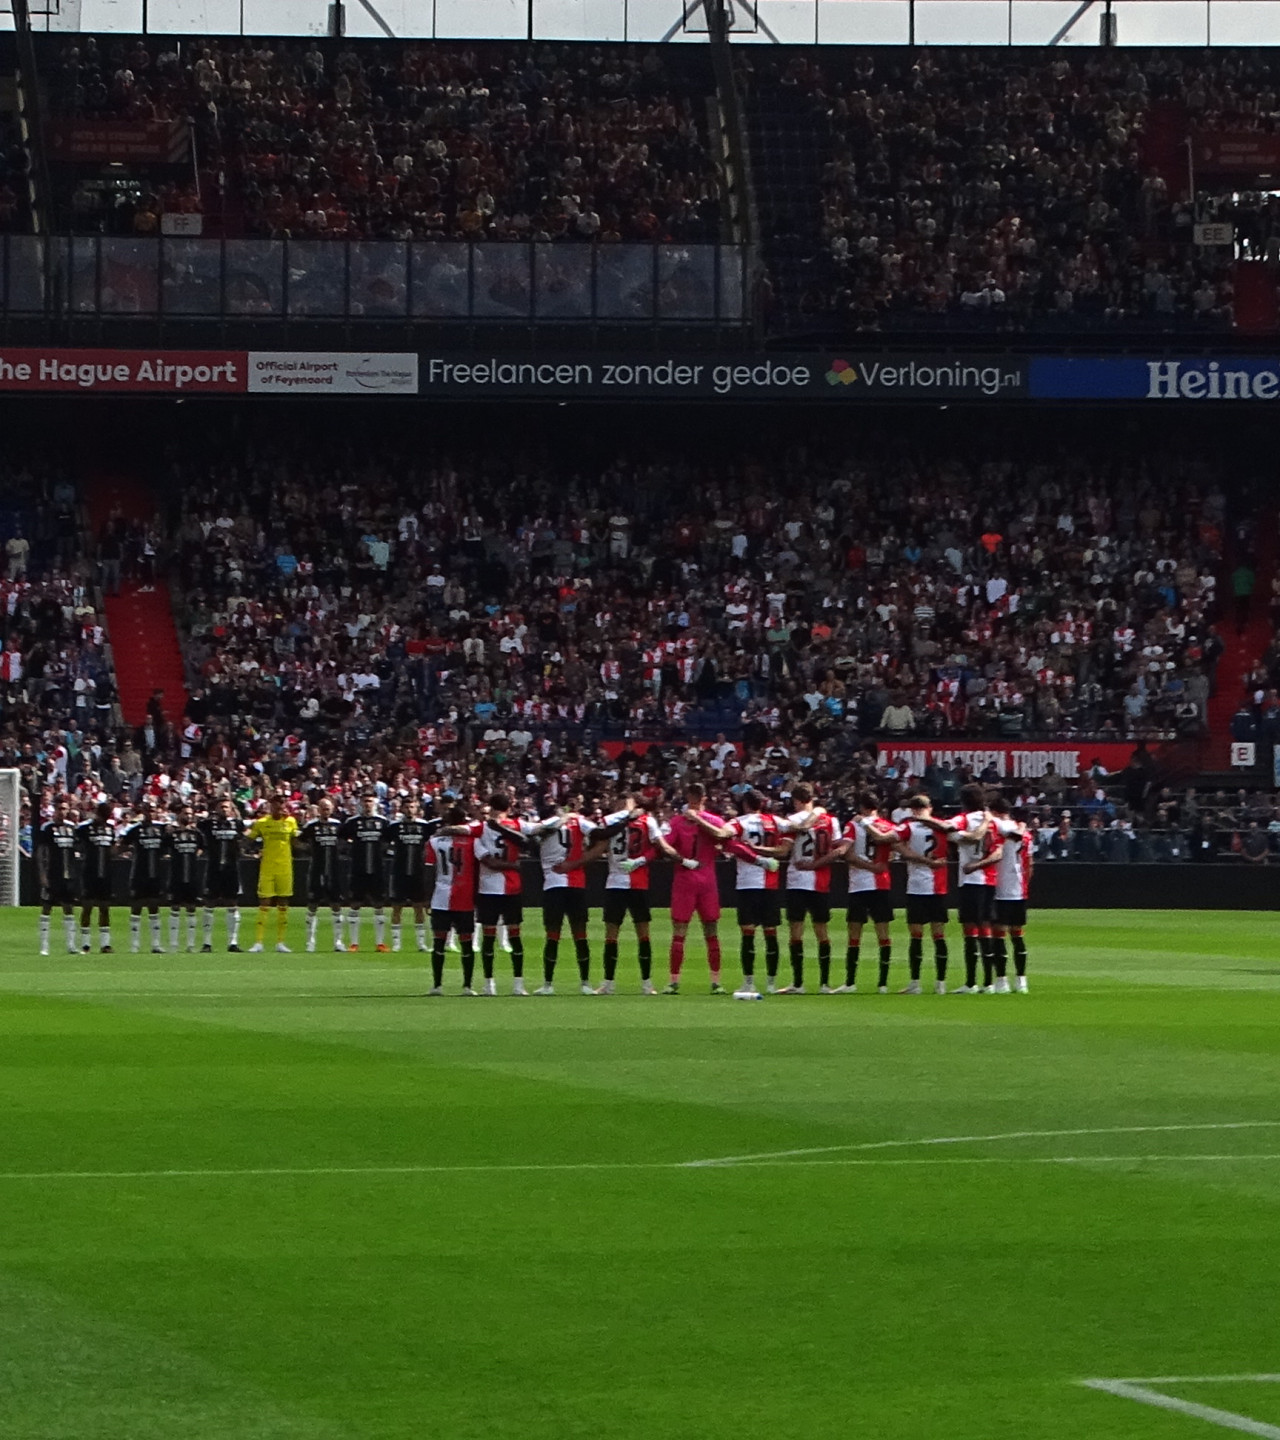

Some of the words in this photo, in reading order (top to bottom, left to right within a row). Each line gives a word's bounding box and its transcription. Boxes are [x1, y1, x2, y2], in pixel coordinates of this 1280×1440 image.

[1202, 227, 1224, 241] EE
[39, 359, 130, 388] Hague
[135, 359, 238, 388] Airport
[256, 361, 297, 371] Official
[299, 361, 338, 372] Airport
[429, 358, 593, 385] Freelancen
[601, 360, 704, 385] zonder
[712, 360, 811, 394] gedoe
[261, 374, 273, 384] of
[275, 374, 333, 386] Feyenoord
[858, 361, 1021, 395] Verloning.nl
[1237, 747, 1249, 762] E
[438, 846, 463, 876] 14
